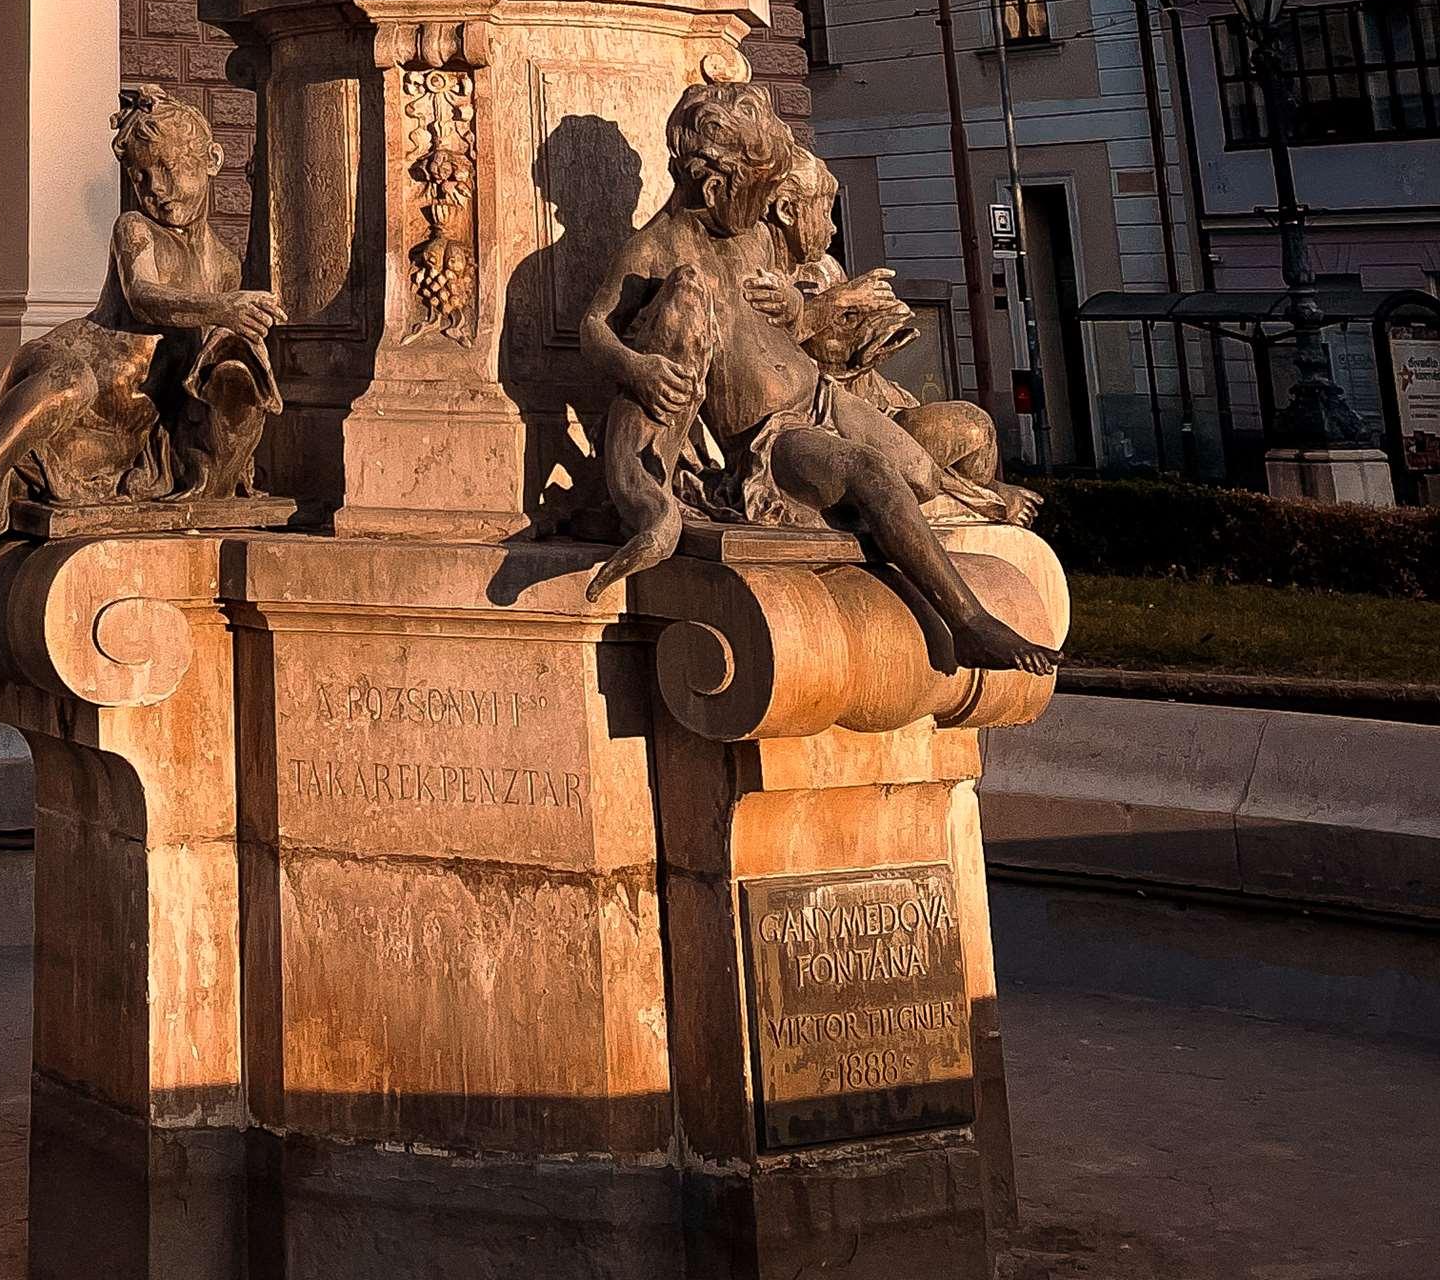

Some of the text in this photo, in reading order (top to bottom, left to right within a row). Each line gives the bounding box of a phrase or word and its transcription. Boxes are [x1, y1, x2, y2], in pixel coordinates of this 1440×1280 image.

[759, 895, 955, 944] GANYMEDOVA
[768, 1012, 861, 1049] VIKTOR
[837, 1048, 899, 1092] 1888
